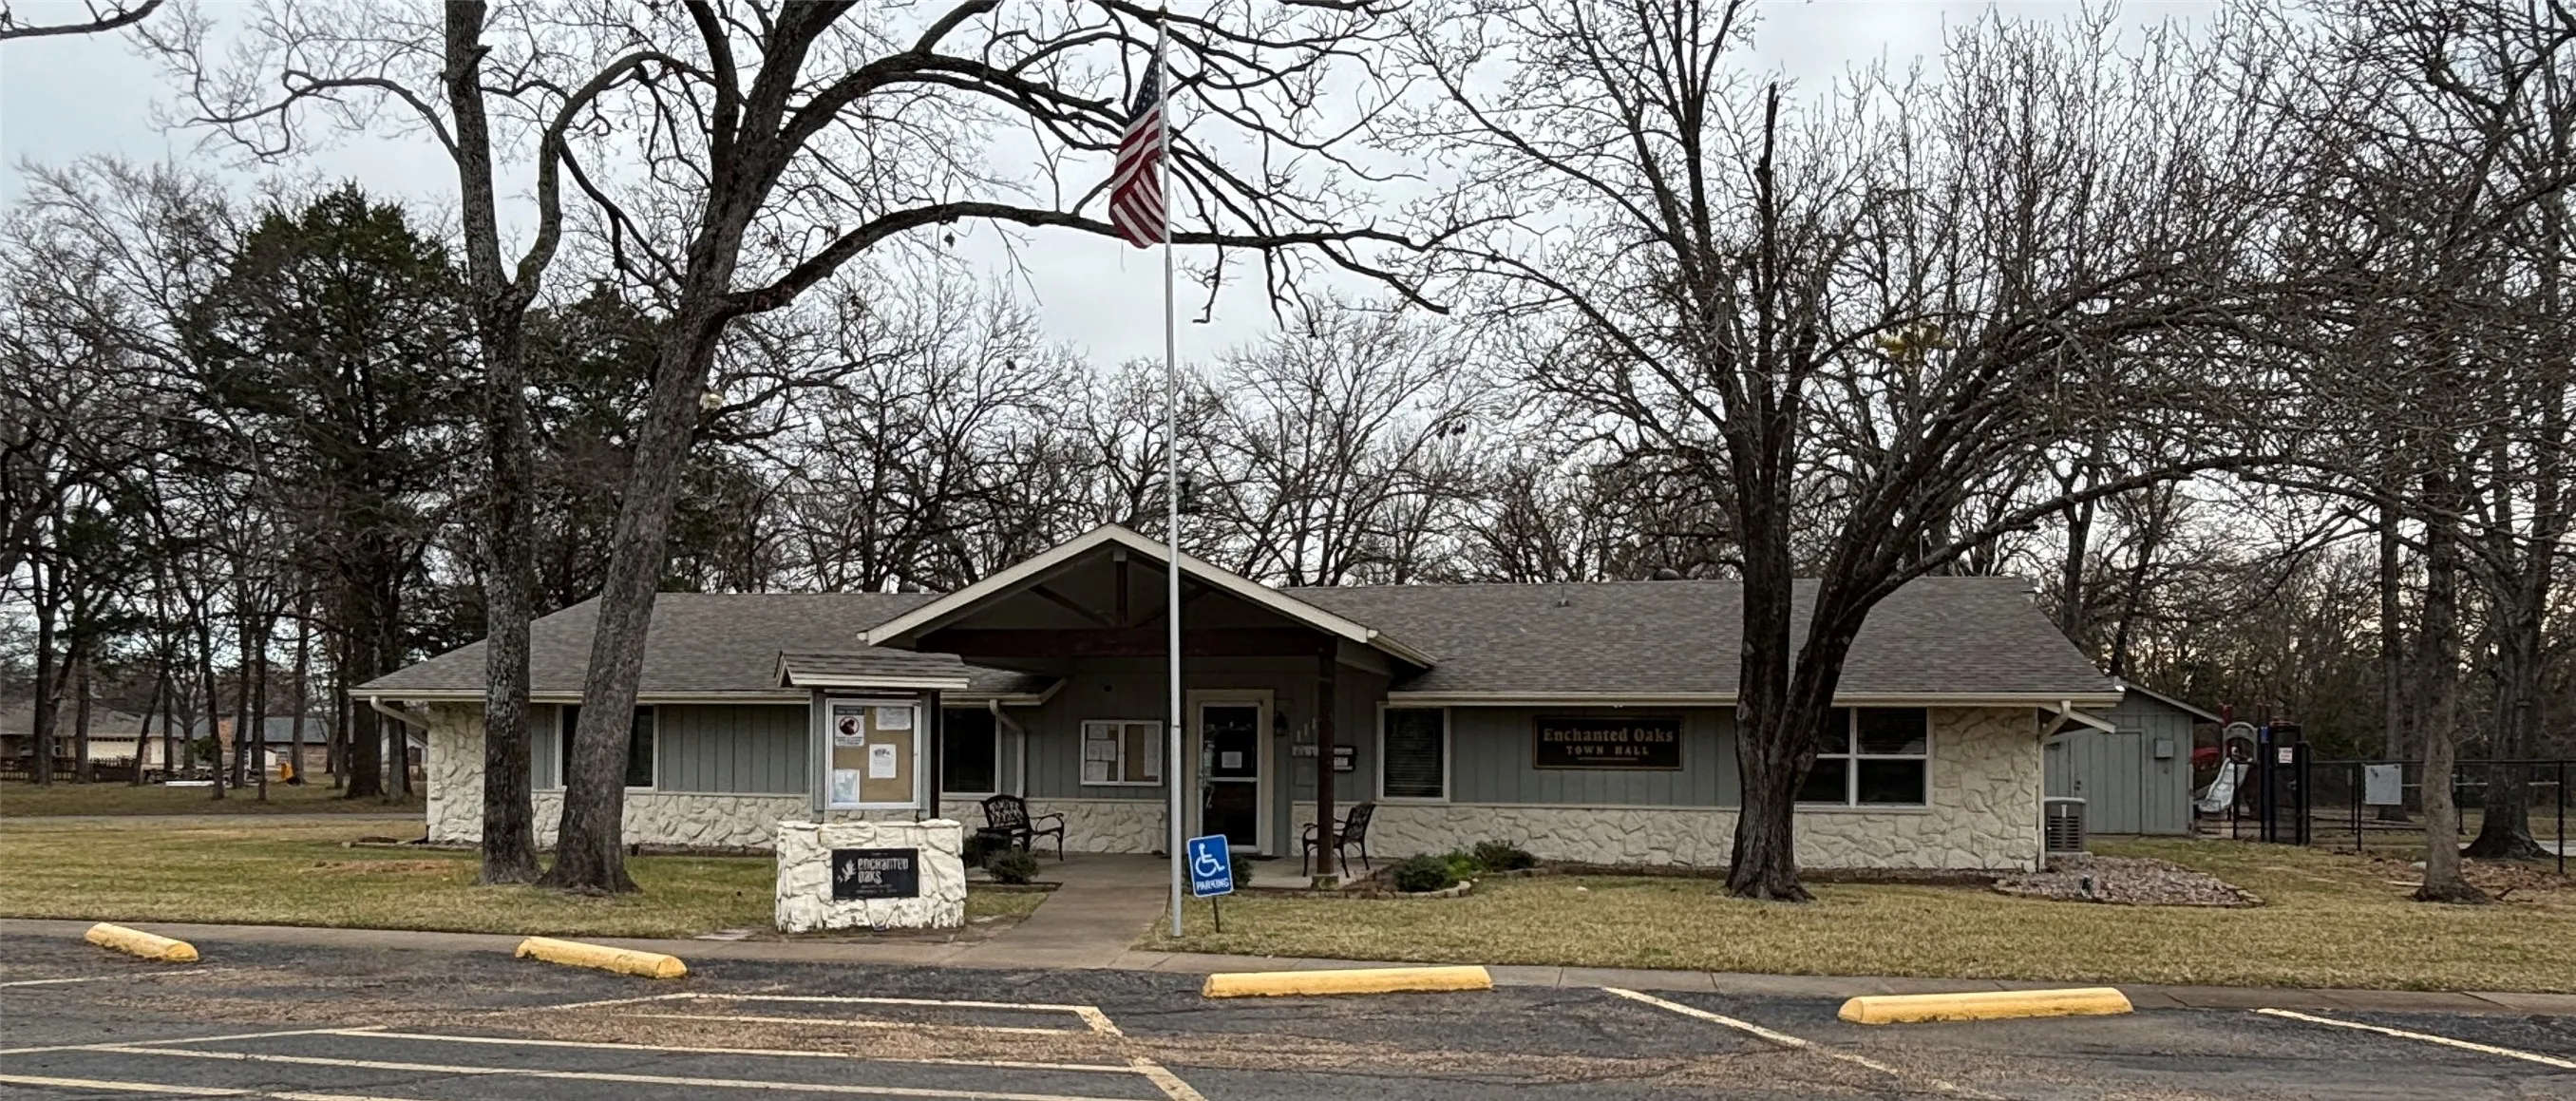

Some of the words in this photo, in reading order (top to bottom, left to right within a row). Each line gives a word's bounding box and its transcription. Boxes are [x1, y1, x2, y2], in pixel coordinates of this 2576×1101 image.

[1543, 728, 1628, 742] Enchanted
[1634, 728, 1674, 742] Oaks
[1566, 746, 1604, 755] TOWN
[1615, 746, 1649, 755] HALL
[1196, 877, 1230, 891] PARKING
